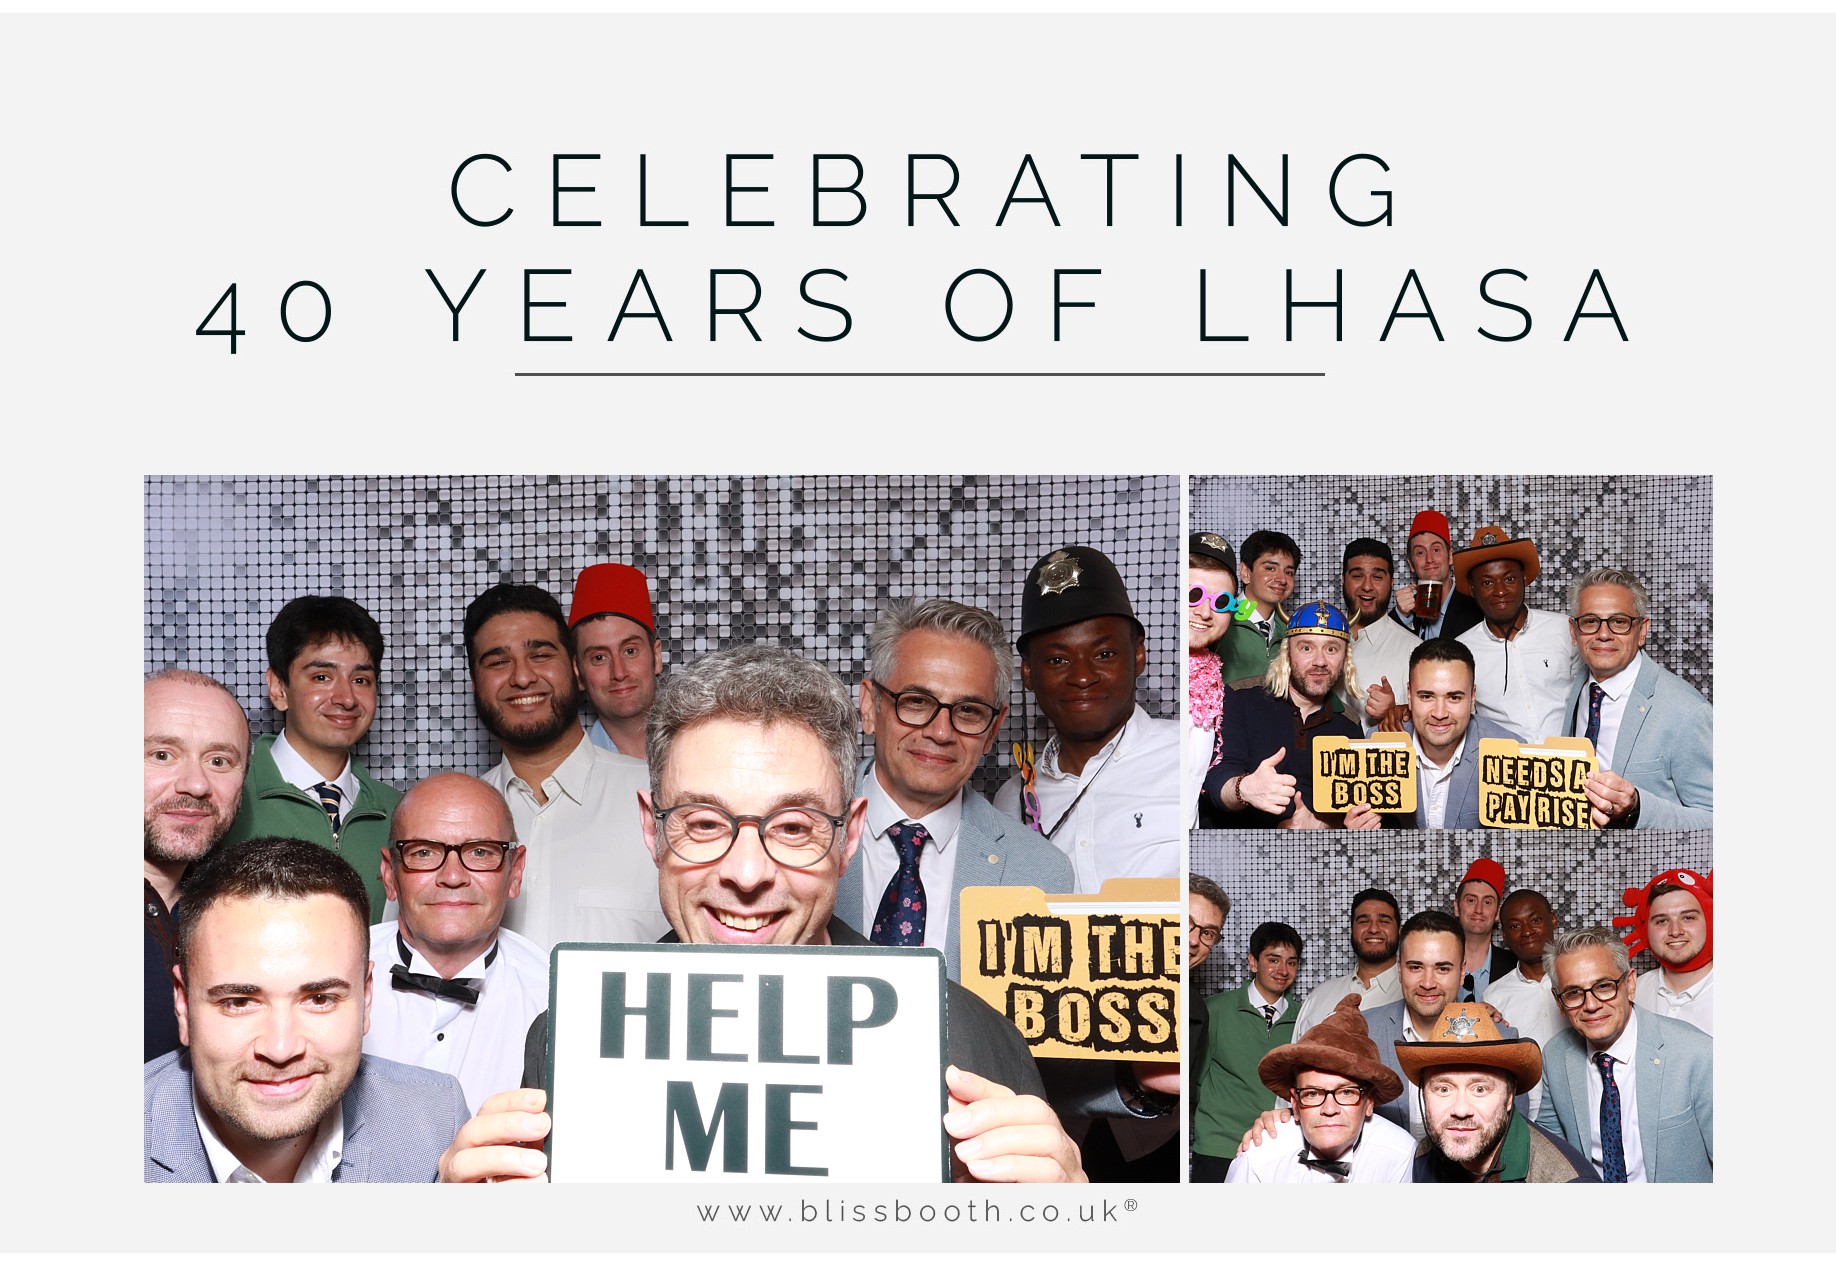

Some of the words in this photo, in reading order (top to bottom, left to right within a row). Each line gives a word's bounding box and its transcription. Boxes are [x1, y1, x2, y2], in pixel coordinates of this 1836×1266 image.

[1322, 751, 1357, 775] I'M
[1367, 751, 1408, 775] THE
[1485, 757, 1564, 788] NEEDS
[1572, 760, 1588, 790] A
[1334, 781, 1400, 806] BOSS
[1487, 793, 1529, 822] PAY
[1537, 795, 1589, 829] RISE
[984, 920, 1065, 975] I'M
[600, 971, 899, 1065] HELP
[1012, 988, 1173, 1046] BOSS
[665, 1080, 829, 1177] ME
